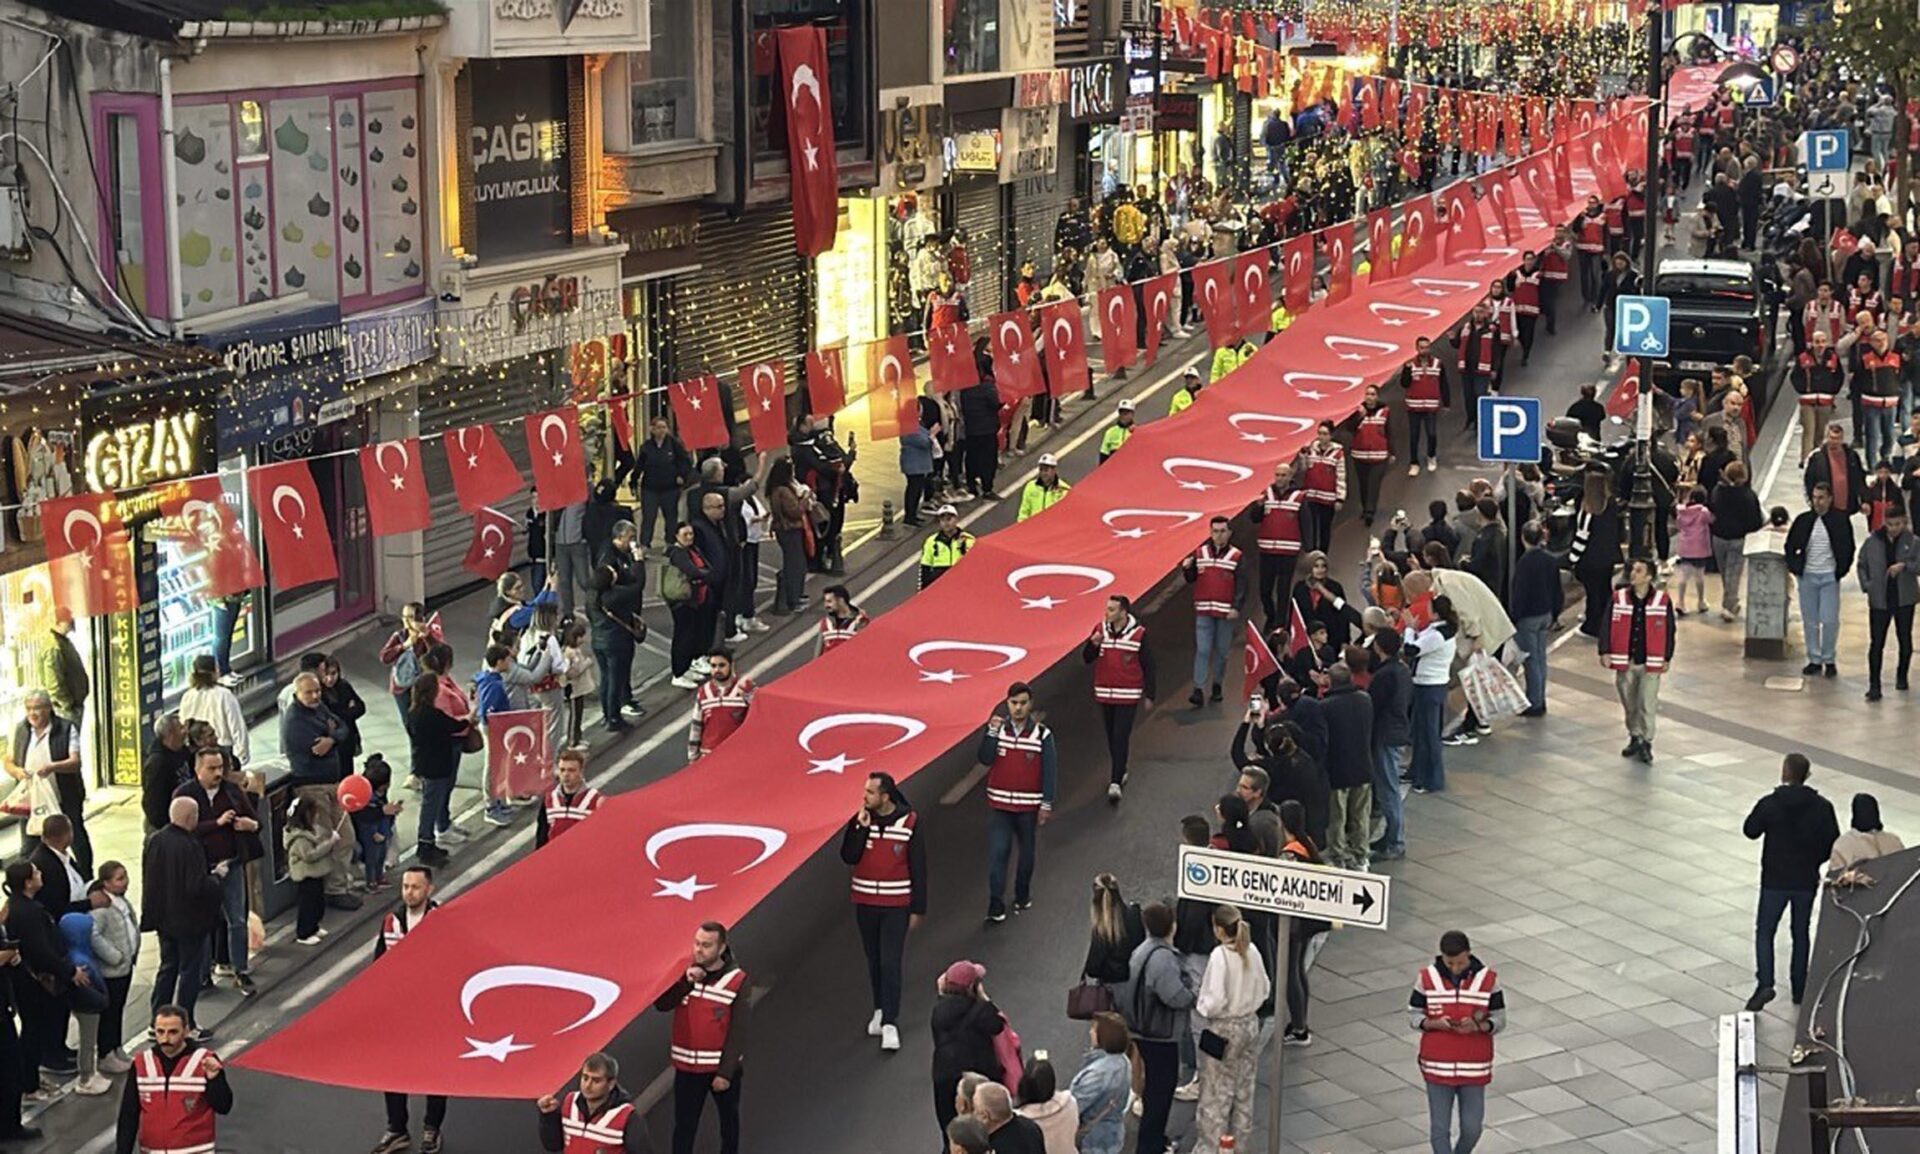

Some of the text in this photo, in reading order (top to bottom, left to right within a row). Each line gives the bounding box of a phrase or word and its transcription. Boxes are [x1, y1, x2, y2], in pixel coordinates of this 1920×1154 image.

[1815, 135, 1839, 167] P
[1622, 303, 1650, 347] P
[1492, 404, 1528, 455] P
[1213, 864, 1344, 904] TEK GENÇ AKADEMİ
